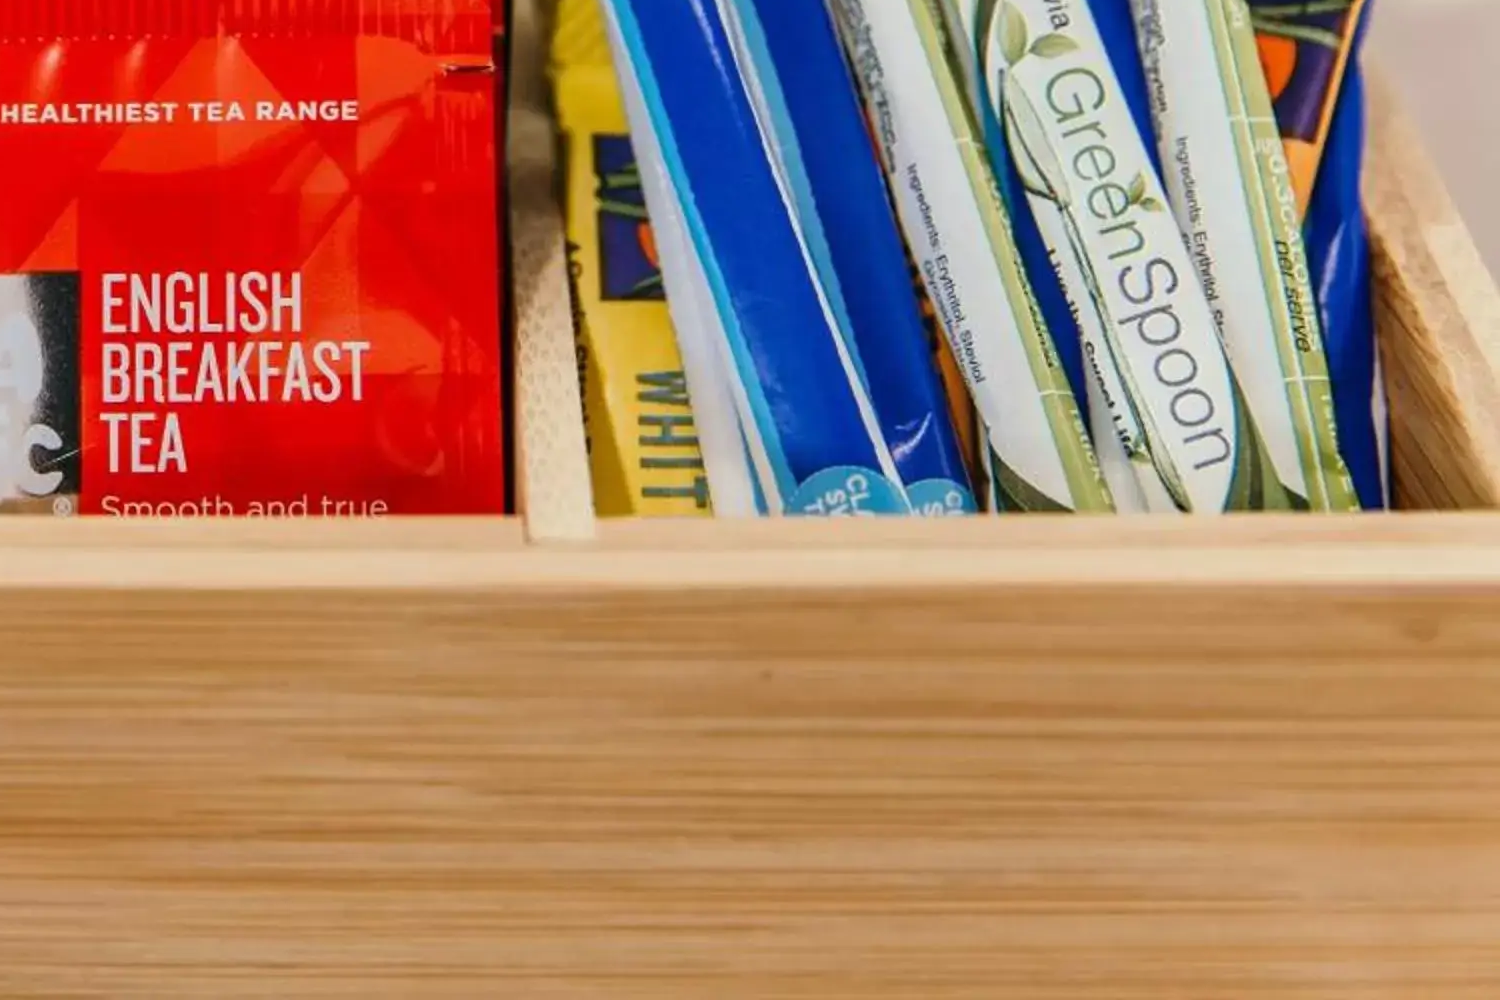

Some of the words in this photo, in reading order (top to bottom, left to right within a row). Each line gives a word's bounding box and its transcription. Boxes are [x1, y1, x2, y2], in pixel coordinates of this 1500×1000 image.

[0, 102, 176, 124] HEALTHIEST
[187, 101, 245, 123] TEA
[256, 100, 359, 122] RANGE
[101, 272, 301, 333] ENGLISH
[1285, 286, 1311, 353] serve
[101, 342, 369, 403] BREAKFAST
[959, 330, 987, 384] Steviol
[101, 413, 187, 473] TEA
[246, 494, 308, 518] and
[320, 494, 389, 518] true
